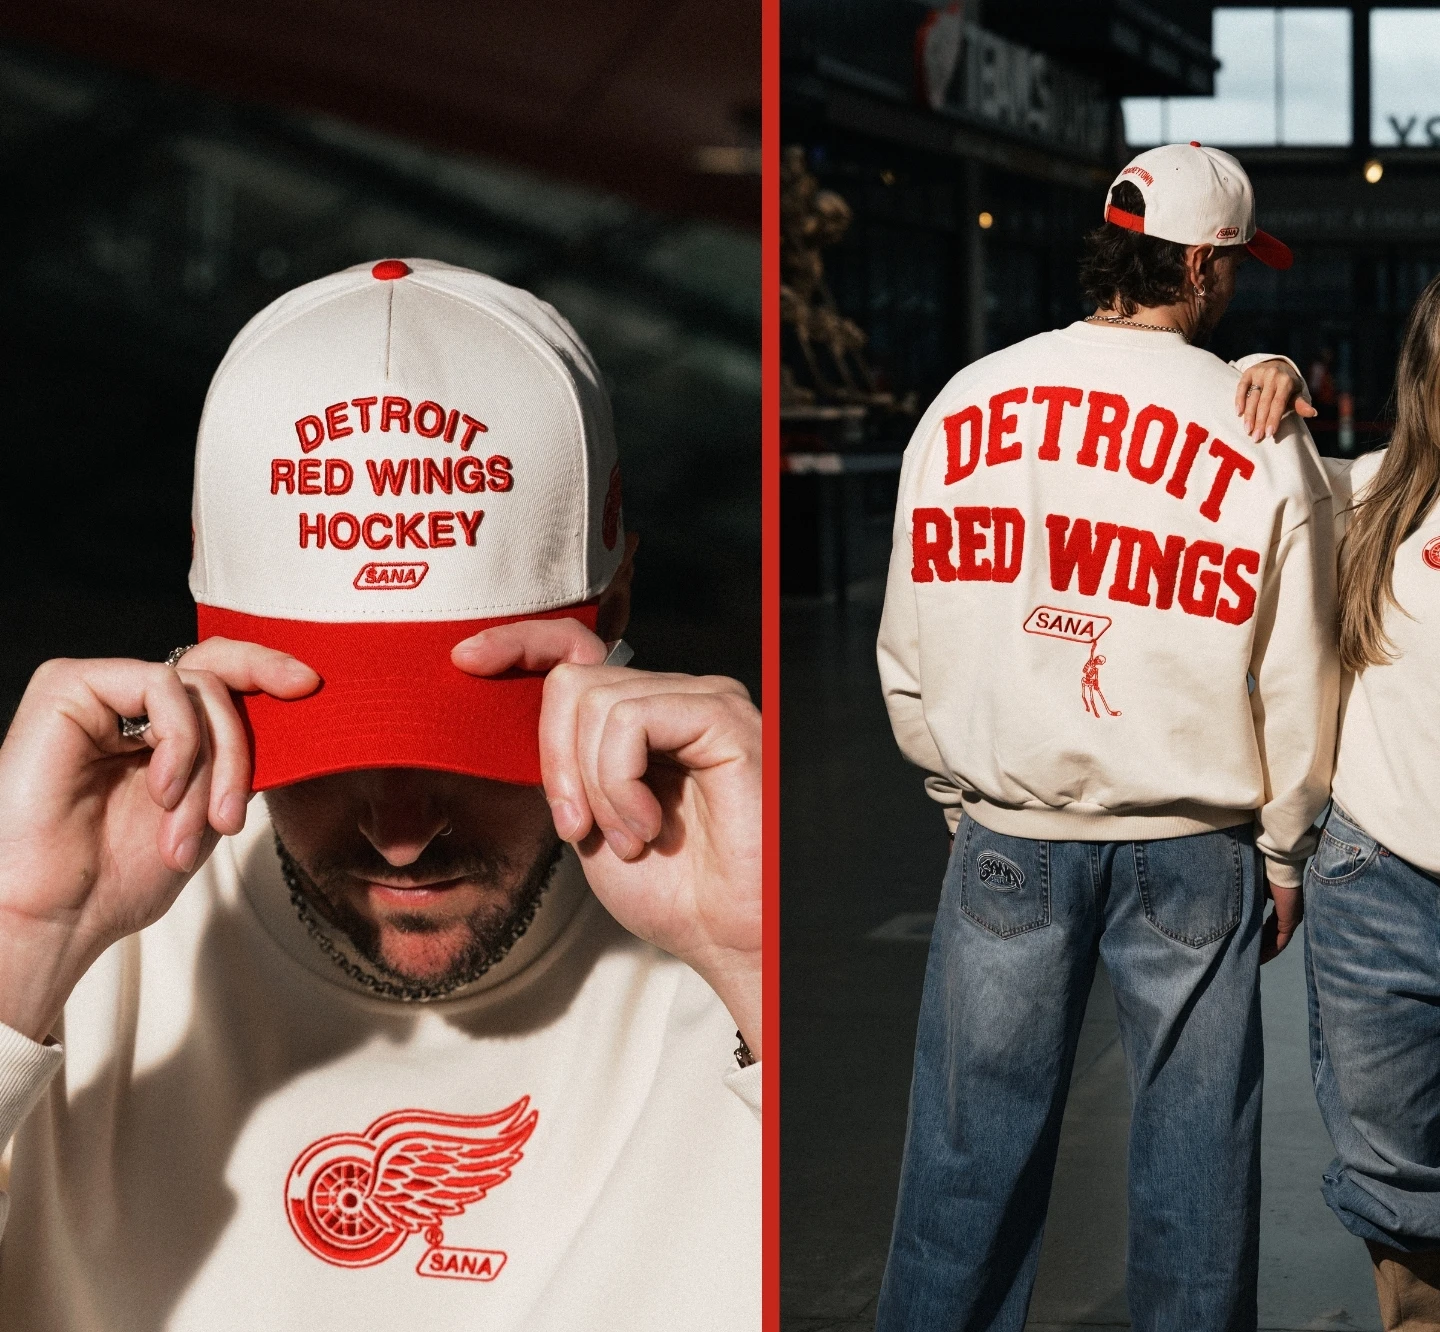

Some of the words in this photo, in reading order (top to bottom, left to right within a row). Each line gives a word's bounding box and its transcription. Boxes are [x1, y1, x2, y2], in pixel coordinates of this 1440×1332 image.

[295, 396, 488, 453] DETROIT
[943, 386, 1255, 523] DETROIT
[271, 458, 354, 496] RED
[366, 455, 515, 496] WINGS
[299, 510, 485, 550] HOCKEY
[365, 568, 416, 584] SANA
[911, 506, 1026, 583] RED
[1045, 513, 1260, 626] WINGS
[1036, 612, 1094, 638] SANA
[430, 1253, 492, 1276] SANA
